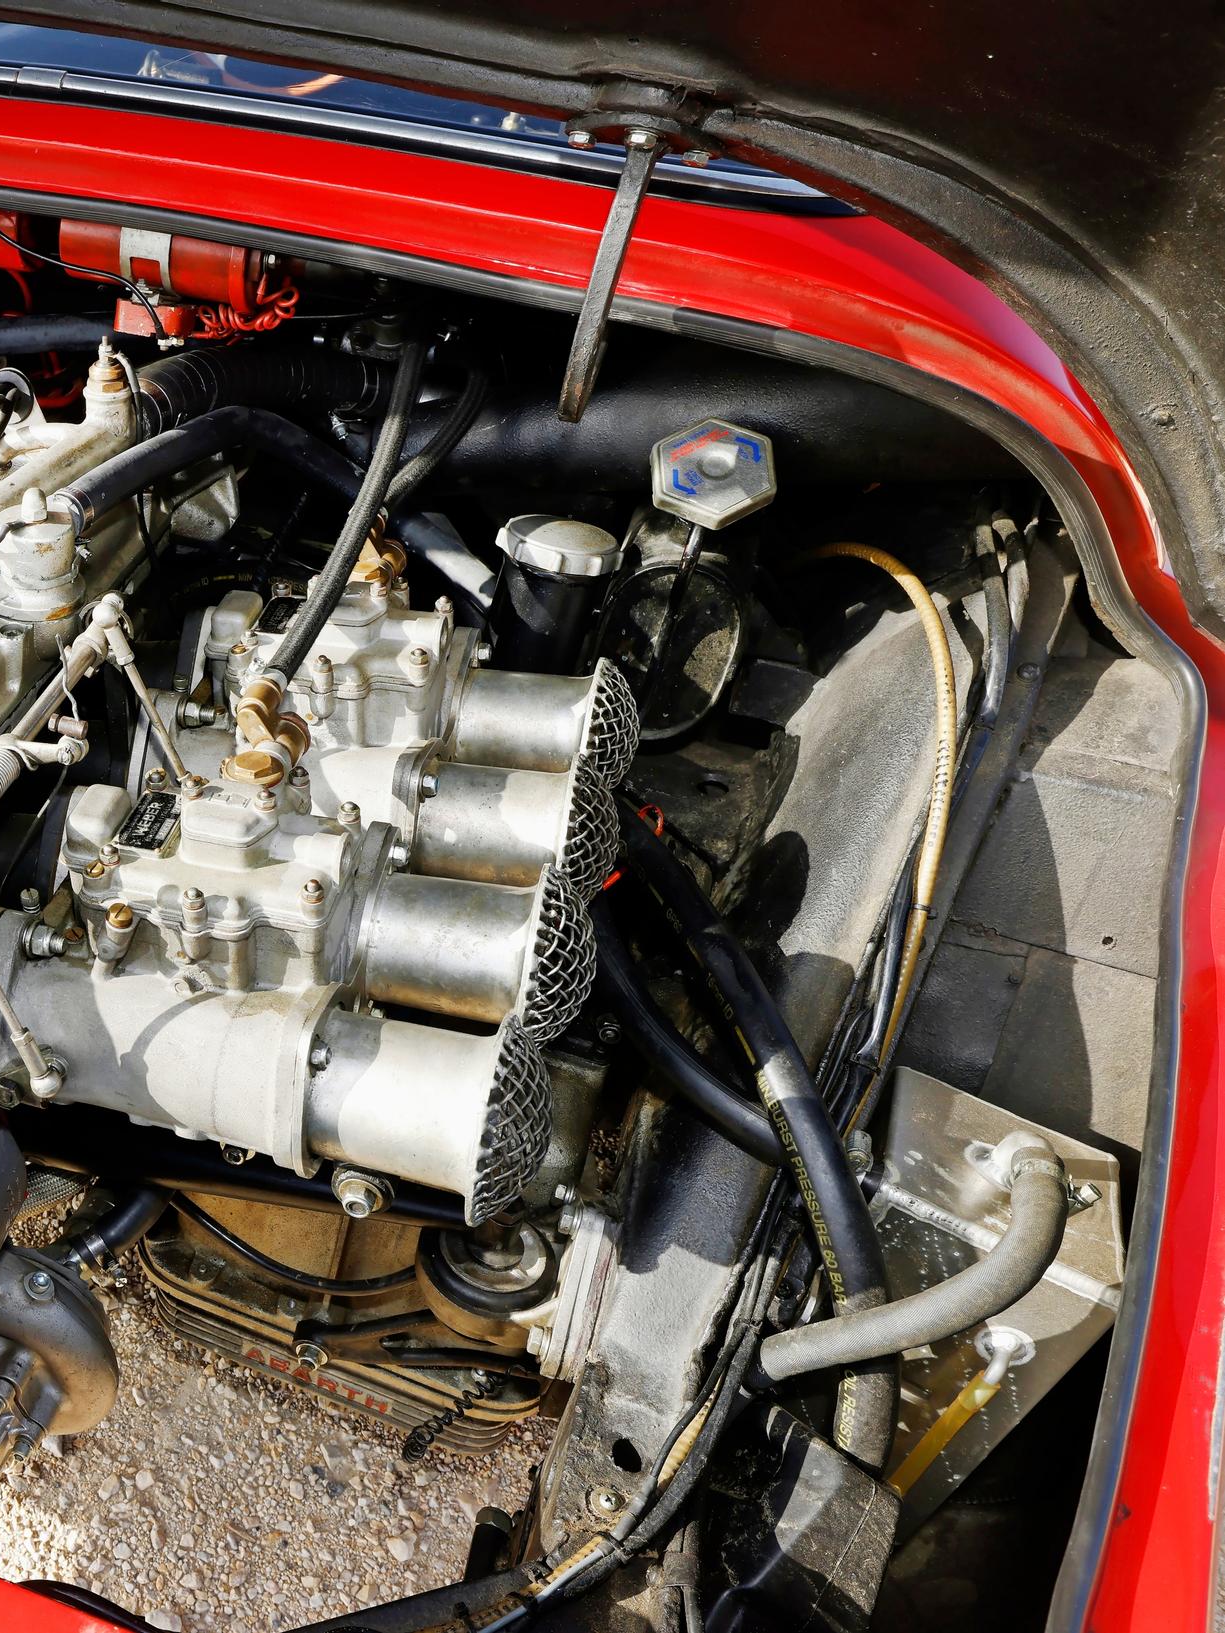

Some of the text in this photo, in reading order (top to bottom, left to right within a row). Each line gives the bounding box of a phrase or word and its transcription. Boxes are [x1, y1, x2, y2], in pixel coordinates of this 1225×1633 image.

[131, 802, 165, 836] WEBER
[790, 1156, 832, 1247] PRESSURE
[823, 1249, 838, 1270] 60
[830, 1271, 848, 1305] BAR
[245, 1347, 389, 1416] ABARTH
[844, 1369, 857, 1392] OIL
